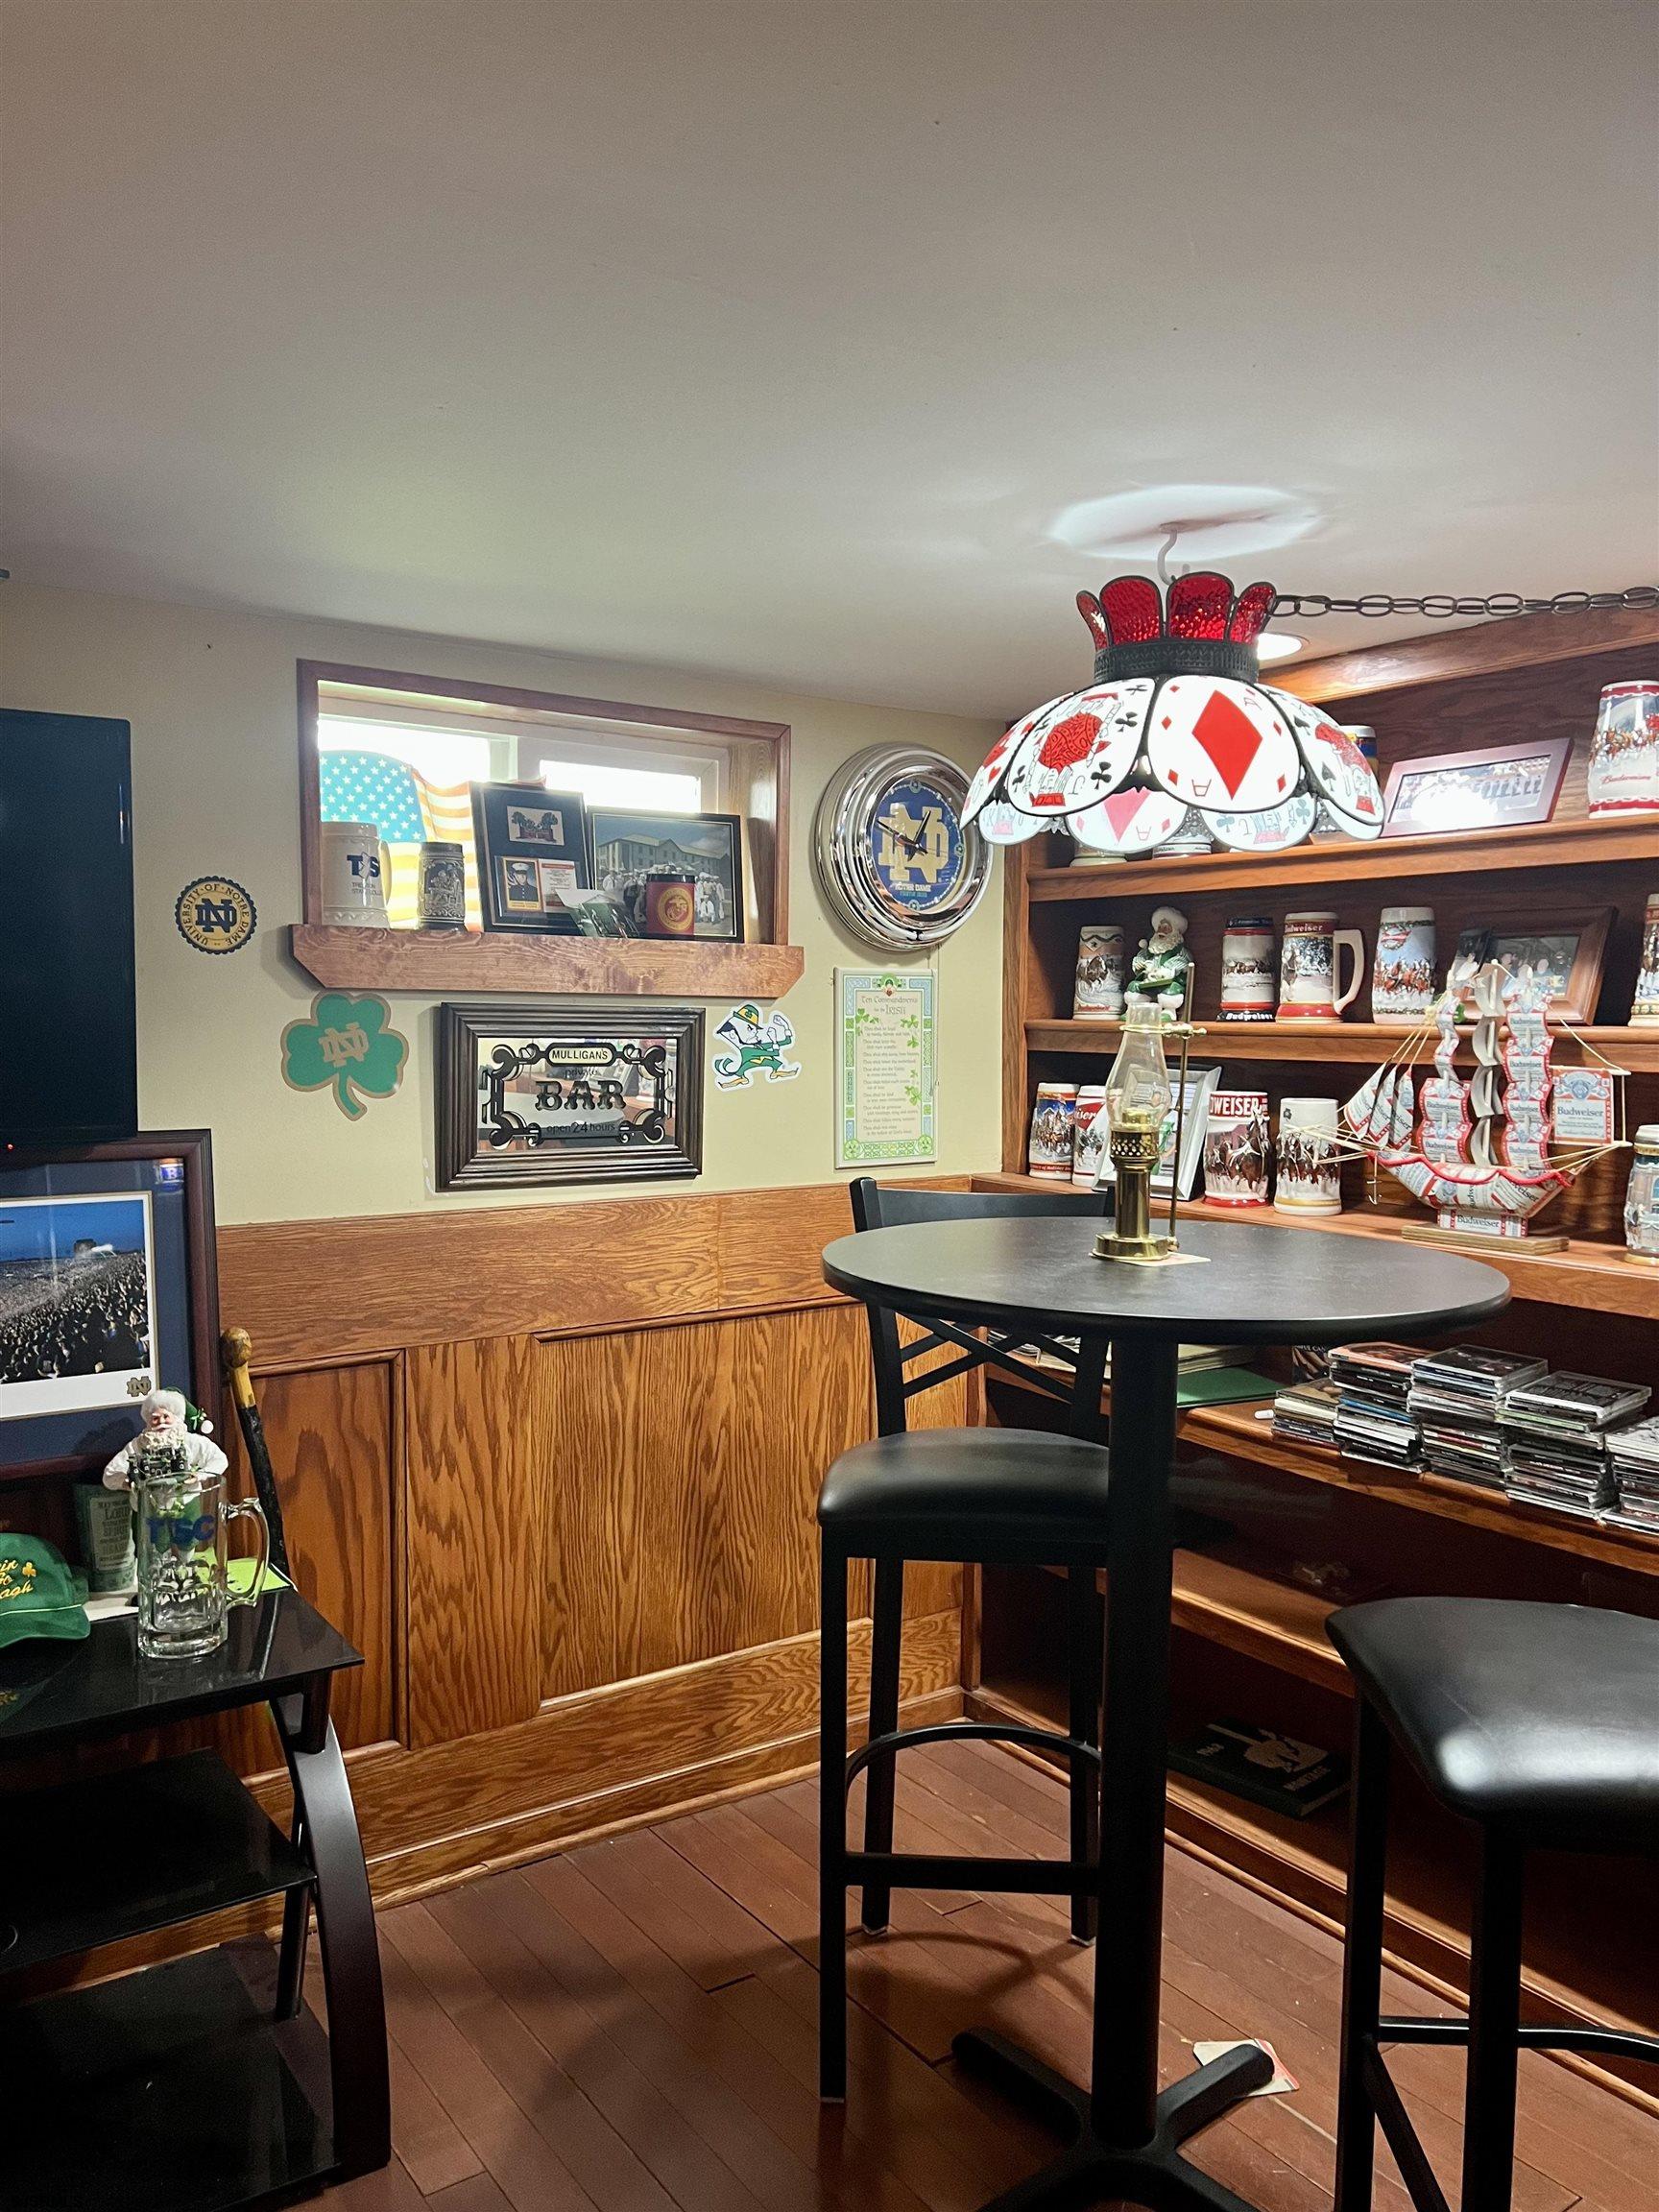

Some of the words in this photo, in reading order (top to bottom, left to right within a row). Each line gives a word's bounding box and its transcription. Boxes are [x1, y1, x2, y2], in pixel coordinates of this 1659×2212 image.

[204, 883, 221, 892] OF
[226, 887, 250, 918] NOTRE
[182, 888, 208, 946] UNIVERSITY
[195, 898, 237, 933] ND
[225, 921, 250, 946] DAME
[551, 1049, 608, 1060] MULLIGAN'S
[565, 1069, 598, 1080] private
[535, 1080, 627, 1111] BAR
[1557, 1106, 1604, 1117] Budweiser
[546, 1124, 571, 1137] open
[571, 1121, 588, 1134] 24
[589, 1122, 615, 1133] hours
[1457, 1214, 1500, 1228] Budweiser
